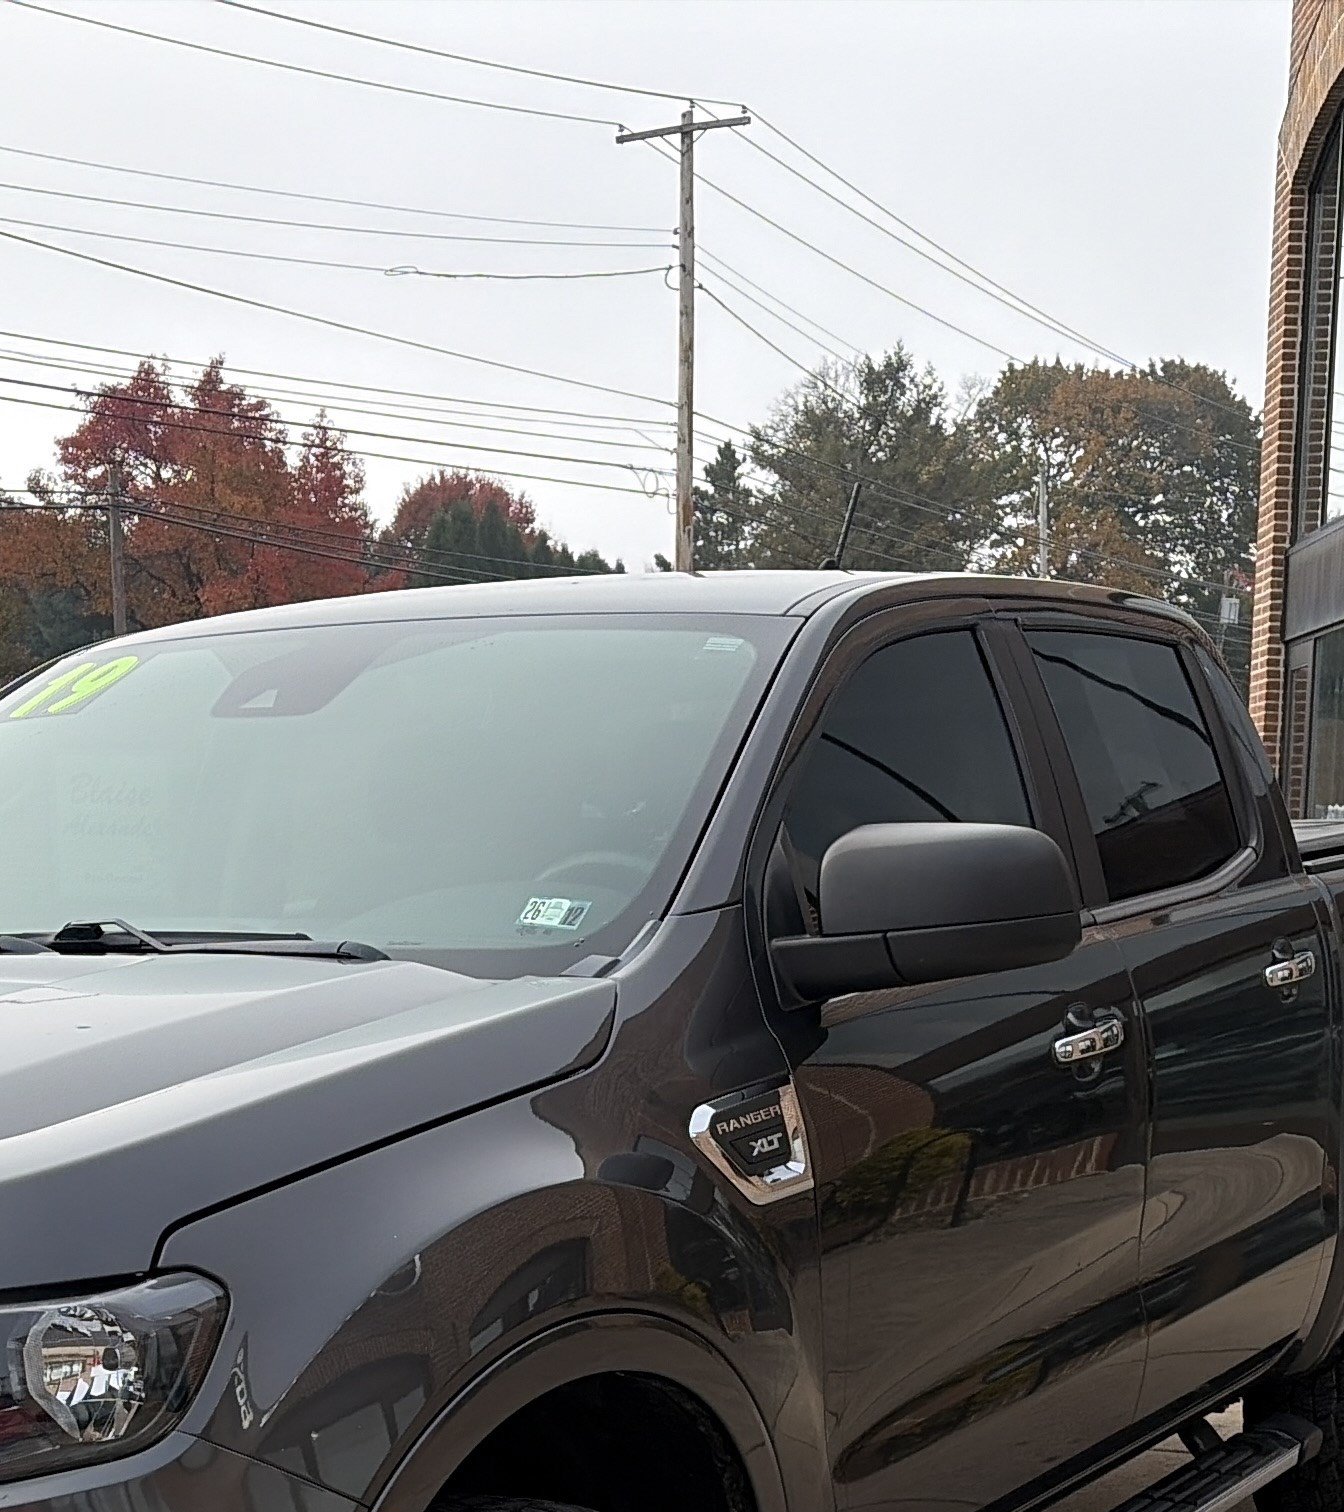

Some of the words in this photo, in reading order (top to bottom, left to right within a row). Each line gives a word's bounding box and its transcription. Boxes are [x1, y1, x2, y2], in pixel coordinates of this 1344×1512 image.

[9, 655, 140, 719] 19
[523, 900, 546, 921] 26
[558, 906, 586, 926] 12
[717, 1105, 781, 1135] RANGER
[749, 1133, 782, 1156] XLT
